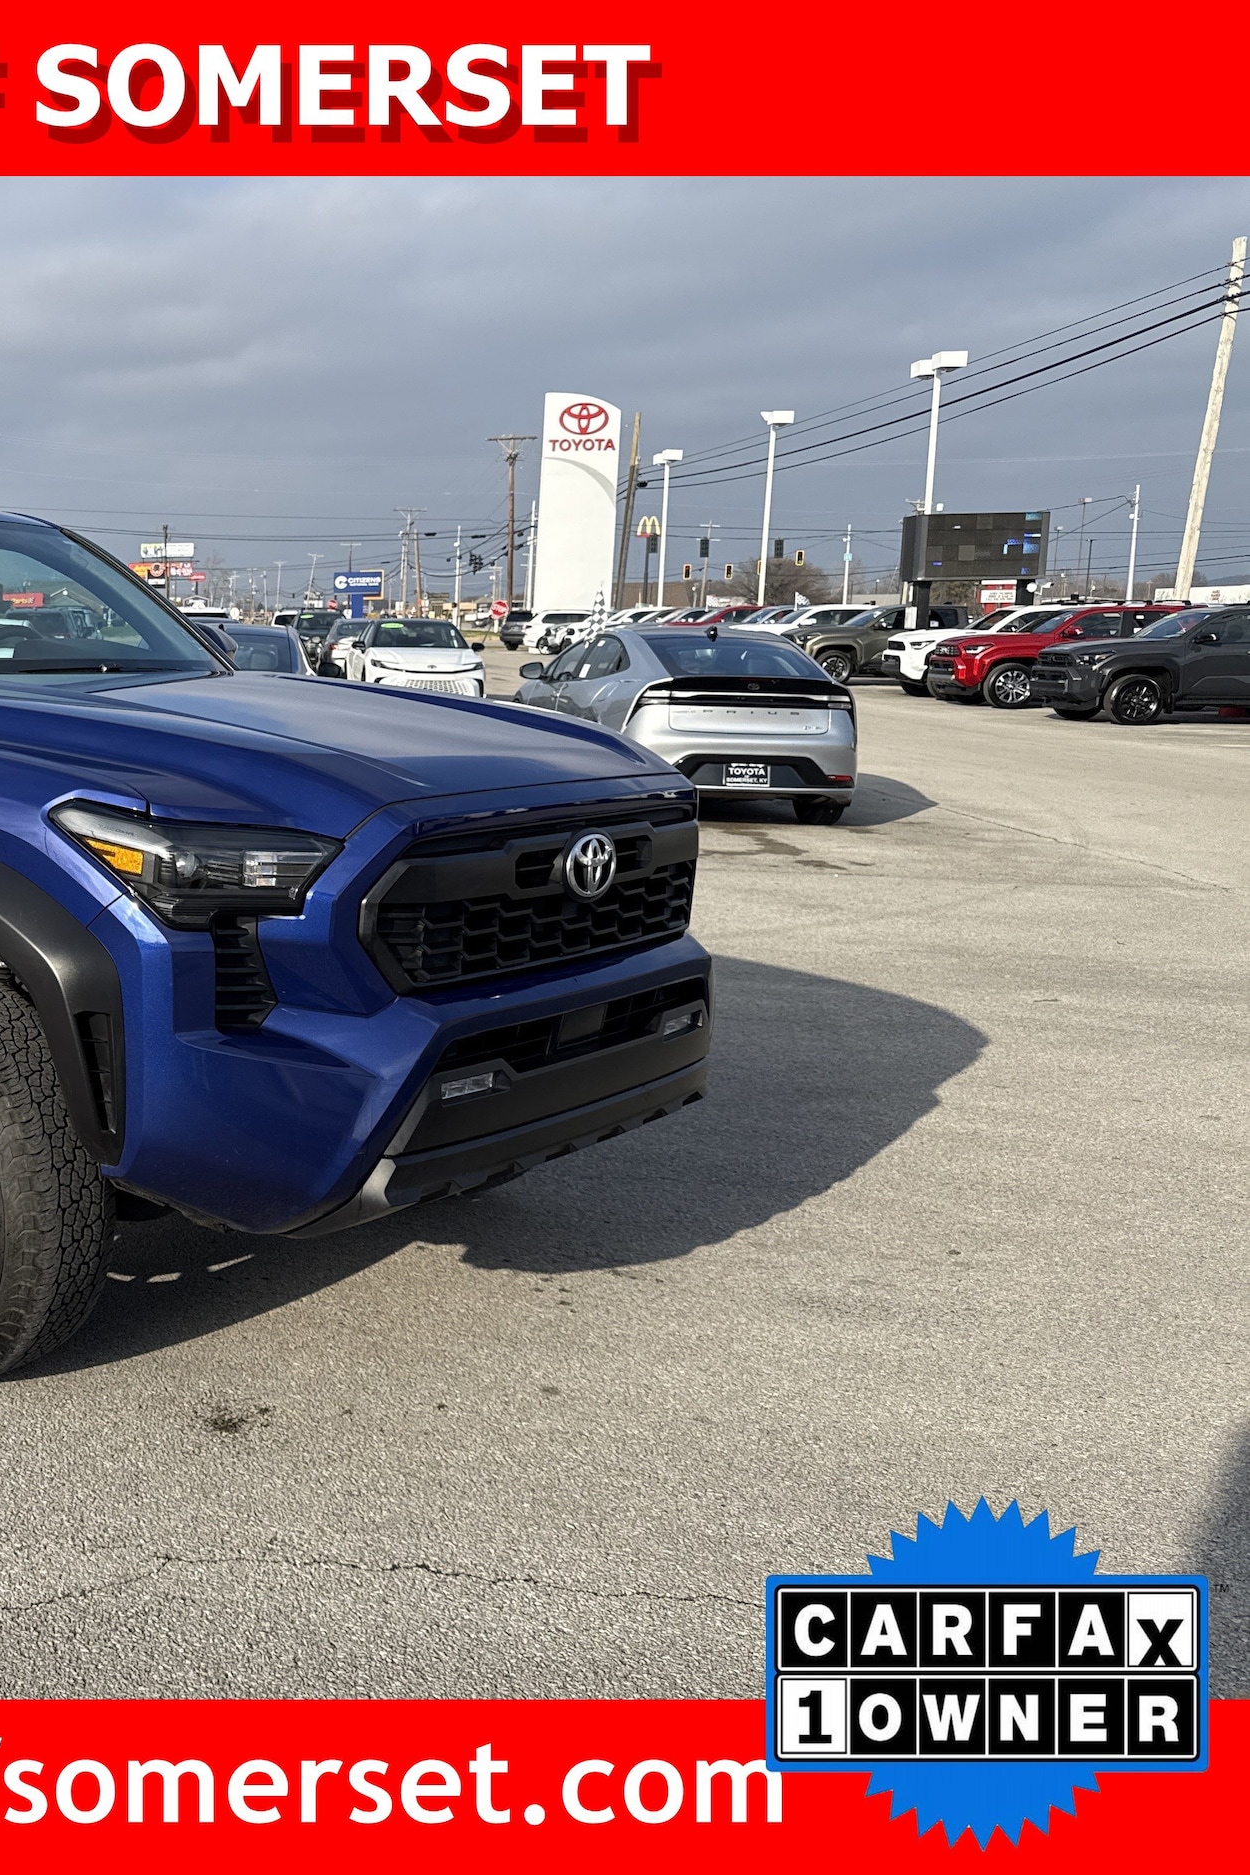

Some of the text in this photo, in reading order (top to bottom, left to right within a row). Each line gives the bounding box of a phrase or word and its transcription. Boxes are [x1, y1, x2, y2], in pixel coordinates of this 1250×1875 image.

[548, 438, 617, 453] TOYOTA
[347, 576, 381, 584] CITIZENS
[728, 767, 766, 776] TOYOTA
